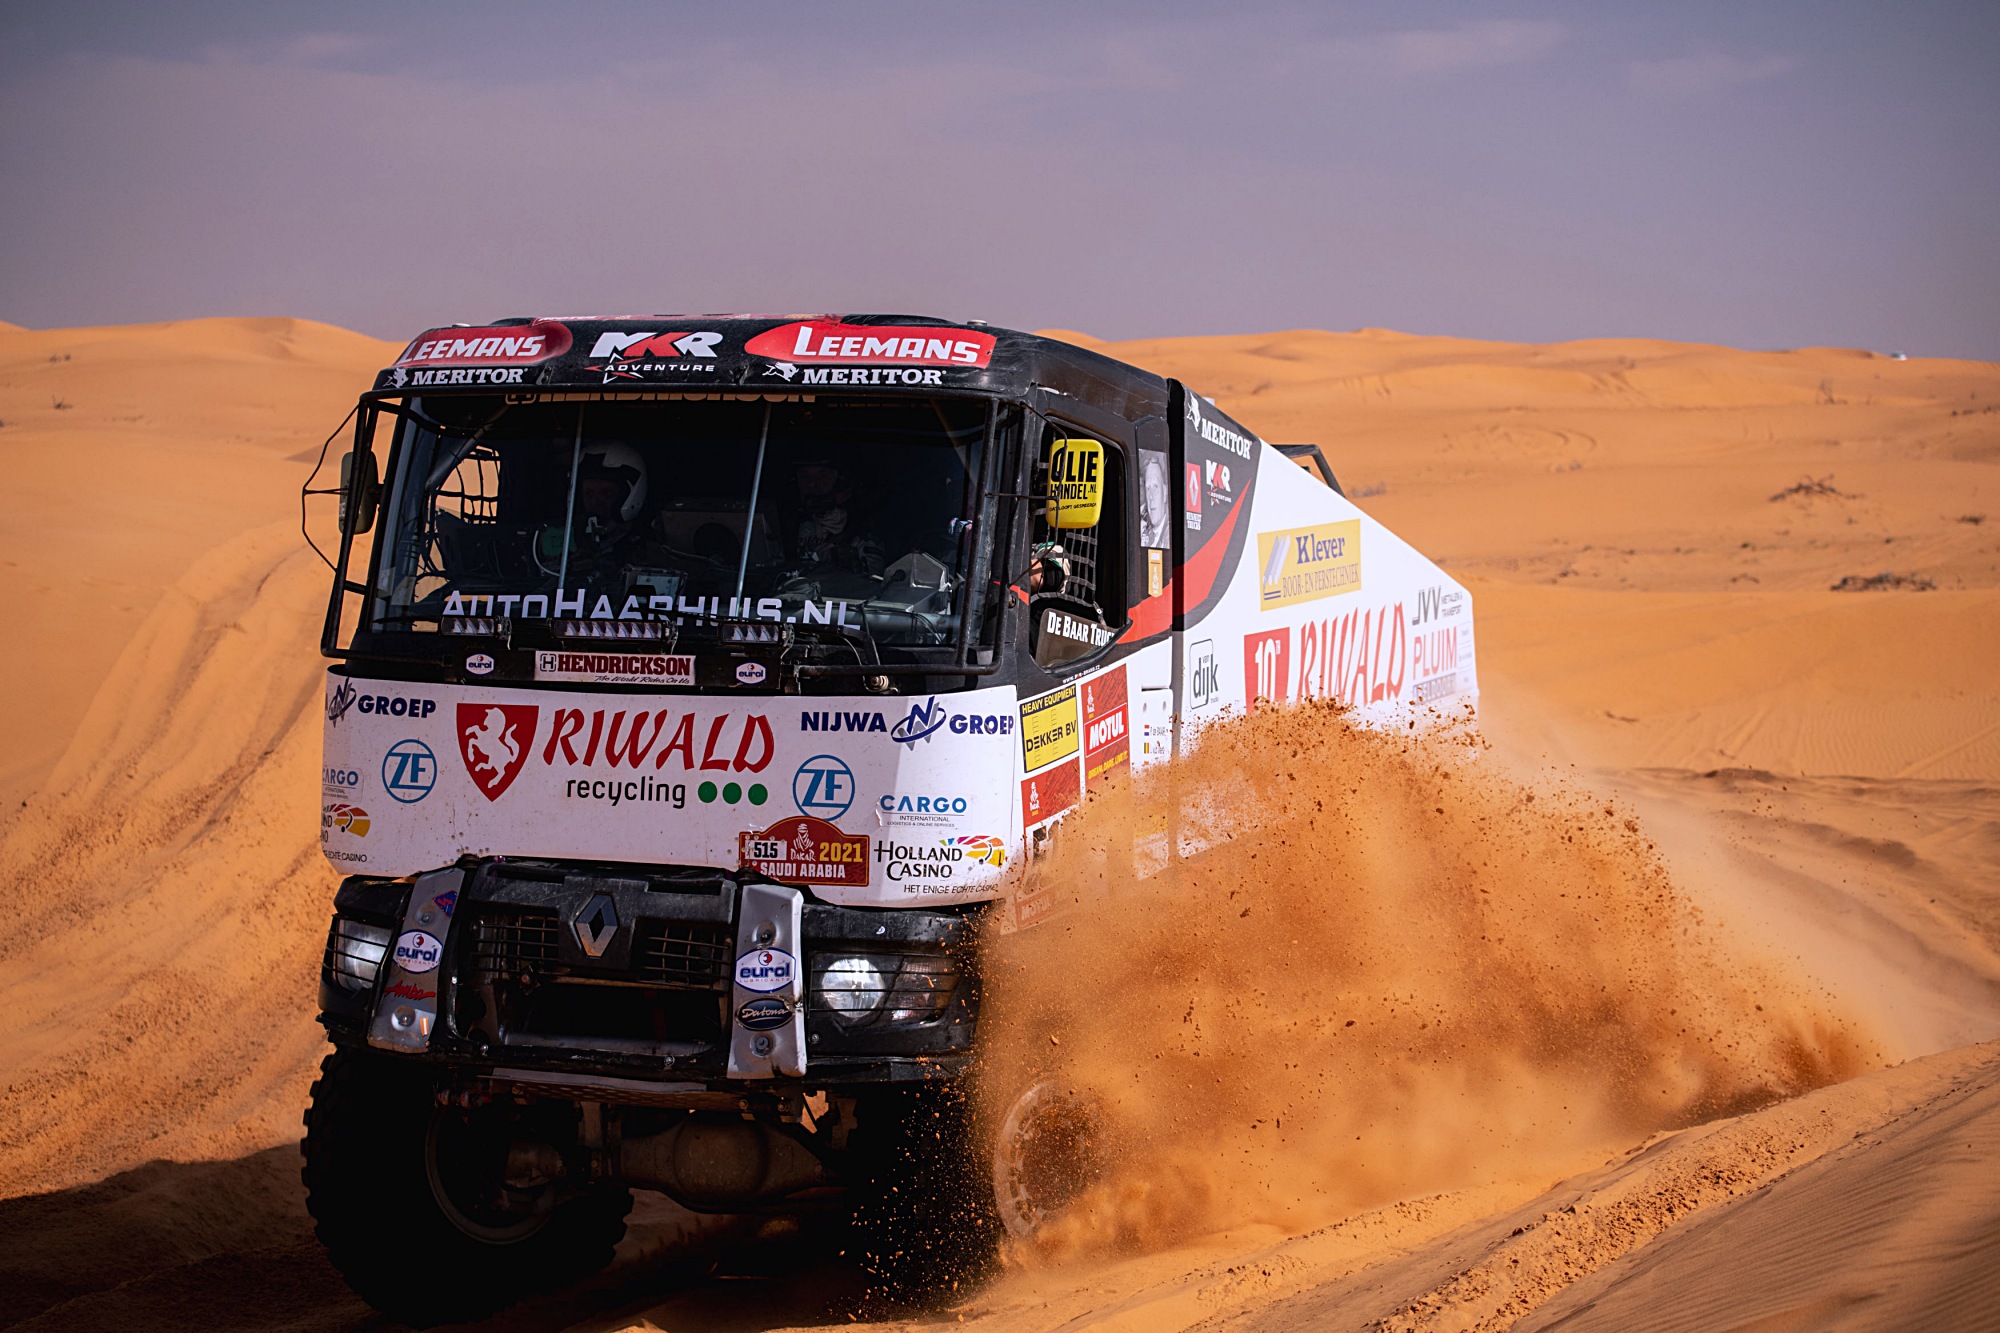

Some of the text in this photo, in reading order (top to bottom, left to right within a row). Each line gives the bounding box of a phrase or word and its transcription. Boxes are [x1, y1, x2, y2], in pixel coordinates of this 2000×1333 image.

[396, 335, 546, 364] LEEMANS
[793, 326, 981, 363] LEEMANS
[411, 368, 524, 386] MERITOR
[604, 364, 715, 372] ADVENTURE
[802, 368, 942, 385] MERITOR
[1201, 418, 1251, 460] MERITOR
[1051, 447, 1098, 482] OLIE
[1295, 533, 1346, 564] Klever
[1062, 615, 1089, 643] BAAR
[558, 654, 691, 676] HENDRICKSON
[1296, 601, 1406, 707] RIWALD
[1412, 626, 1457, 681] PLUIM
[358, 695, 436, 718] GROEP
[1022, 685, 1076, 715] HEAVY EQUIPMENT
[801, 712, 1014, 735] NIJWA GROEP
[1089, 711, 1125, 751] MOTUL
[543, 708, 776, 774] RIWALD
[1026, 720, 1077, 753] DEKKER BV
[388, 752, 433, 790] ZF
[566, 776, 686, 809] recycling
[799, 769, 850, 808] ZF
[880, 794, 967, 814] CARGO
[342, 852, 368, 863] CASINO
[754, 841, 863, 863] 515 2021
[874, 840, 962, 862] HOLLAND
[760, 862, 846, 878] SAUDI ARABIA
[886, 861, 952, 881] CASINO
[904, 884, 920, 893] HET
[923, 885, 950, 894] ENIGE
[396, 946, 437, 962] eurol
[740, 962, 791, 979] eurol
